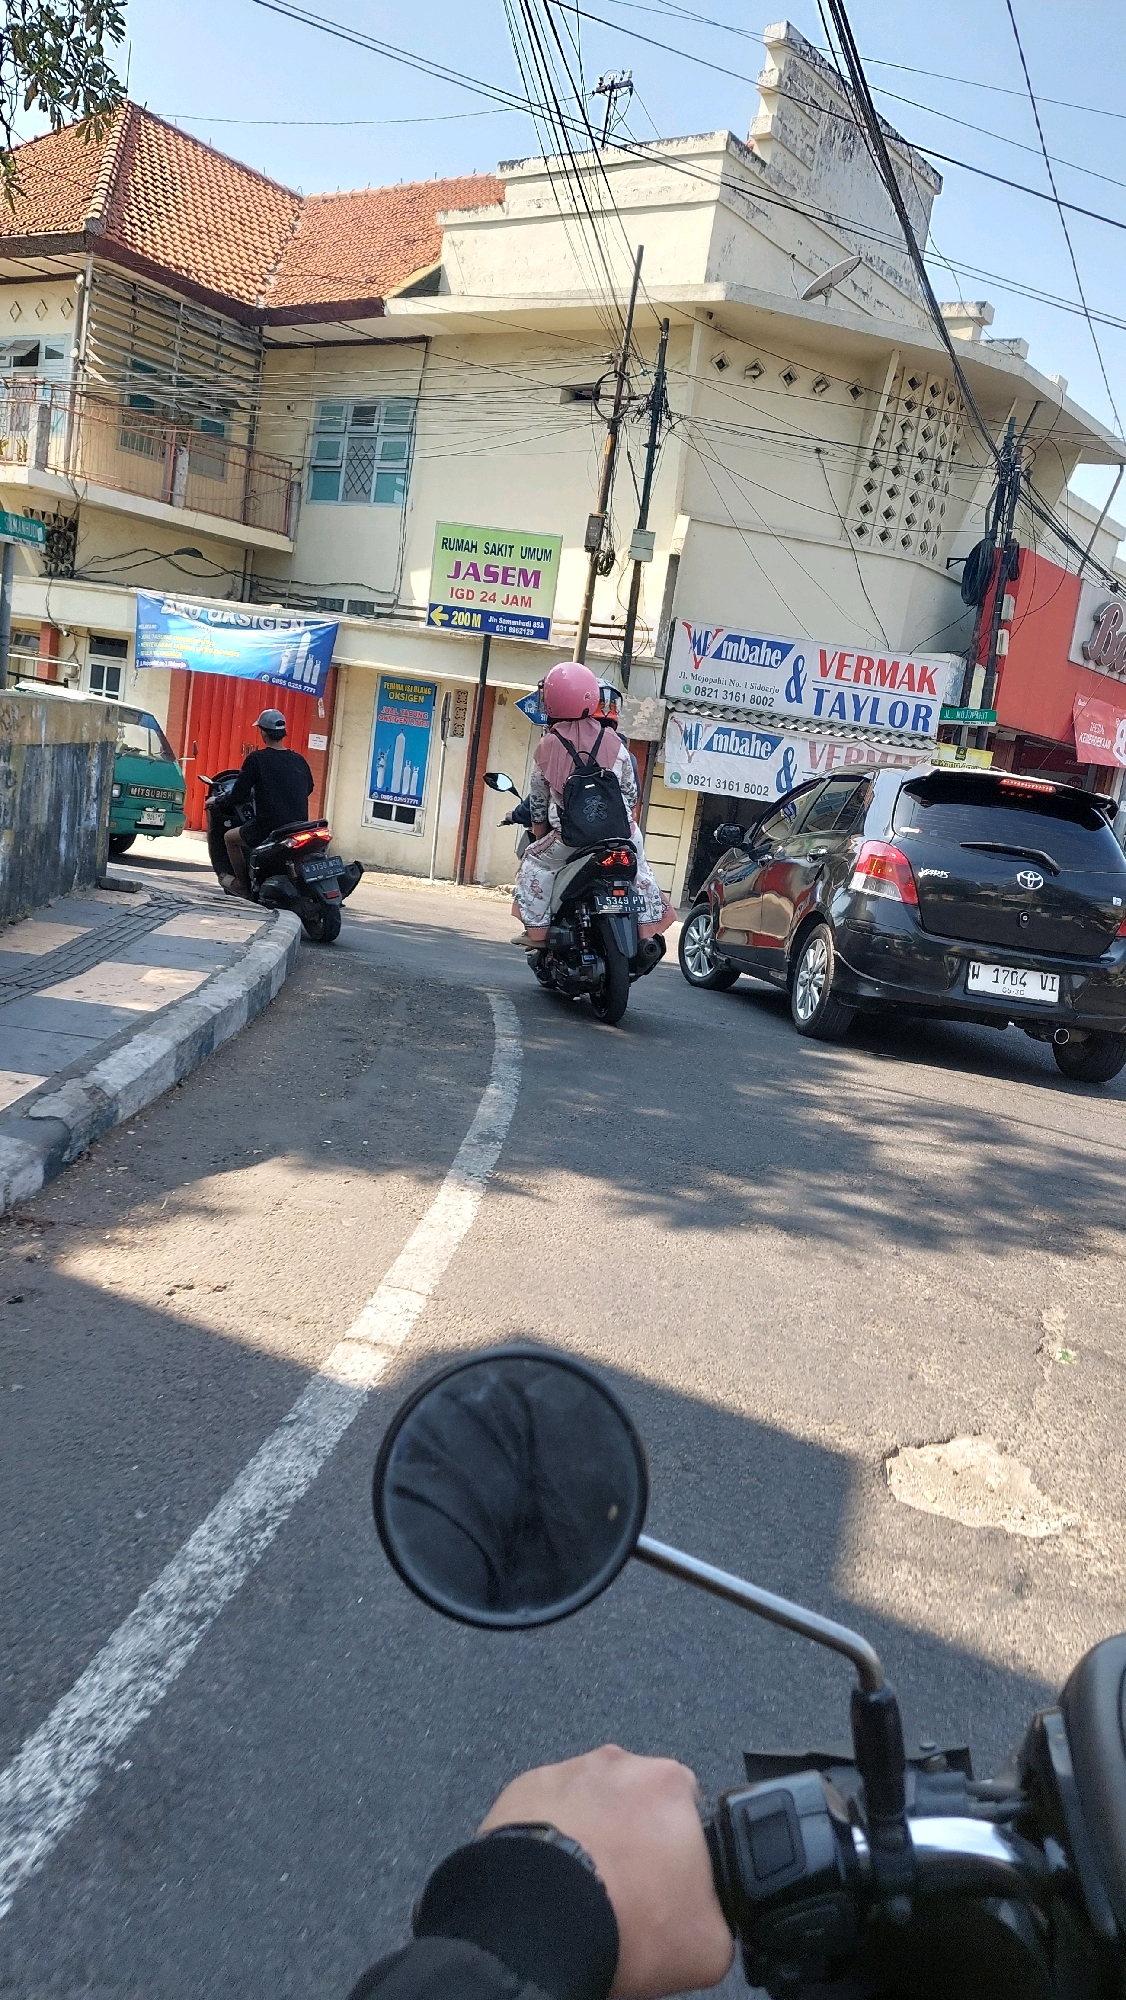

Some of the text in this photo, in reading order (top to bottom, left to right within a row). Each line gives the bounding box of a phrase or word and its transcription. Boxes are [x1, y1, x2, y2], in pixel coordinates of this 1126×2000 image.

[441, 537, 553, 562] RUMAH SAKIT UMUM
[447, 560, 541, 589] JASEM
[450, 587, 532, 608] IGD 24 JAM
[451, 610, 482, 629] 200 M
[488, 615, 498, 623] Jln
[720, 637, 782, 668] mbahe
[679, 671, 688, 680] Jl.
[690, 672, 727, 686] Mojopahit
[729, 678, 742, 688] No.
[750, 682, 780, 695] Sidoarjo
[785, 648, 939, 704] & VERMAK
[388, 691, 425, 703] OKSIGEN
[694, 685, 775, 708] 0821 3161 8002
[813, 687, 933, 733] TAYLOR
[712, 731, 772, 760] mbahe
[775, 746, 798, 794] &
[130, 787, 174, 799] MITSUBISHI
[687, 774, 770, 797] 0821 3161 8002
[596, 896, 645, 906] L 5349 PV
[971, 964, 1057, 992] W 1704 VI
